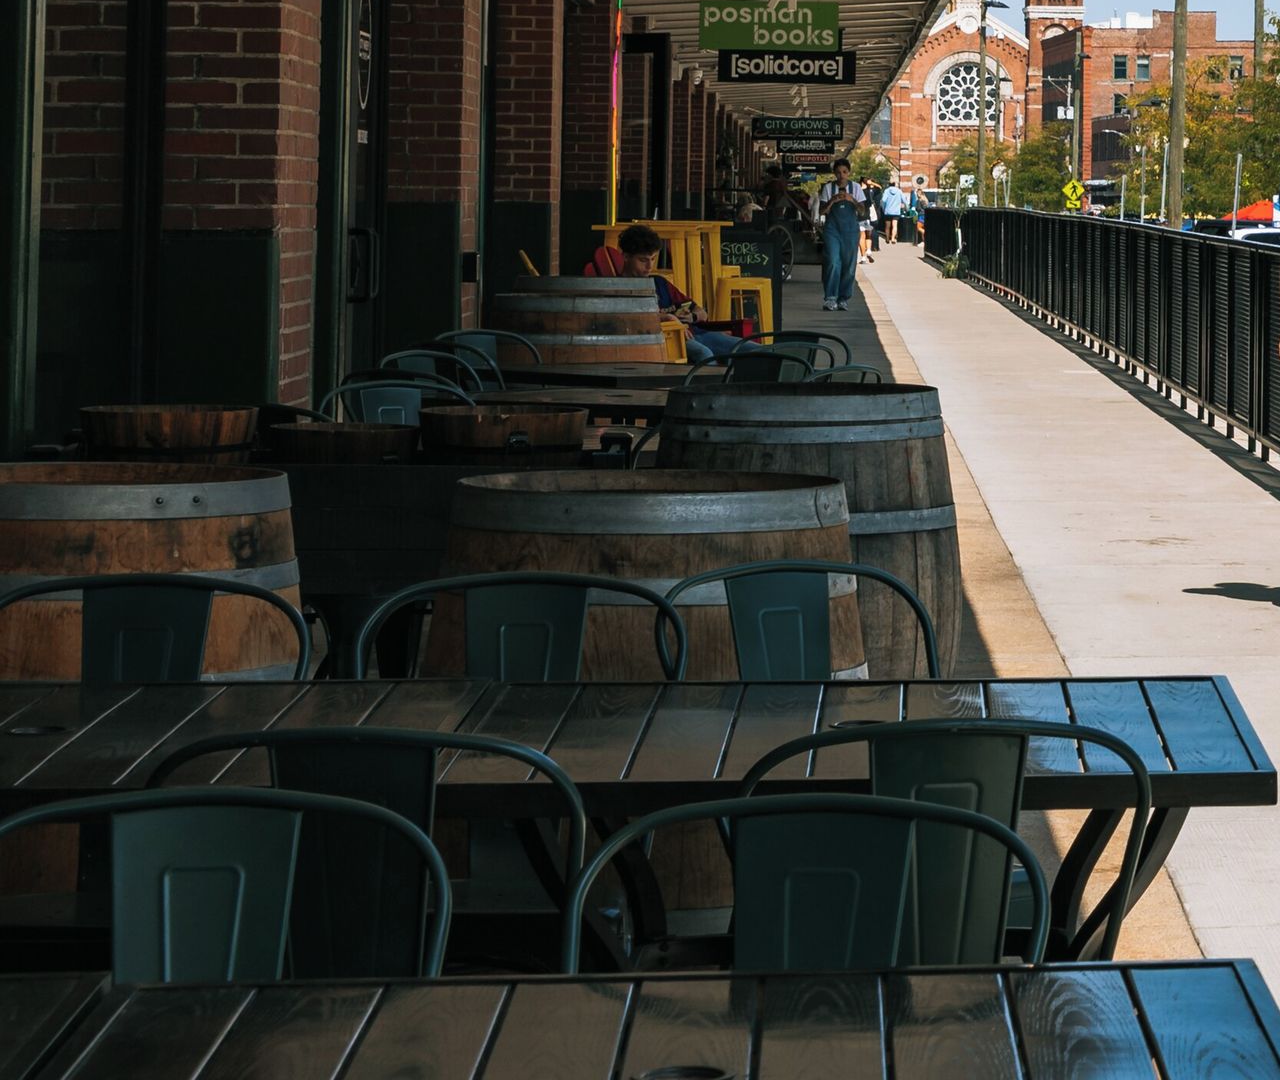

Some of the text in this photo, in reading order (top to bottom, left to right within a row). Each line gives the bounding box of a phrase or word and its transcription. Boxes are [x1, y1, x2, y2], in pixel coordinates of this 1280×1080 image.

[704, 6, 812, 27] posman
[753, 24, 834, 46] books
[731, 53, 843, 80] [solidcore]
[764, 120, 829, 129] CITY GROWS
[721, 241, 759, 255] STORE
[726, 253, 761, 265] HOURS
